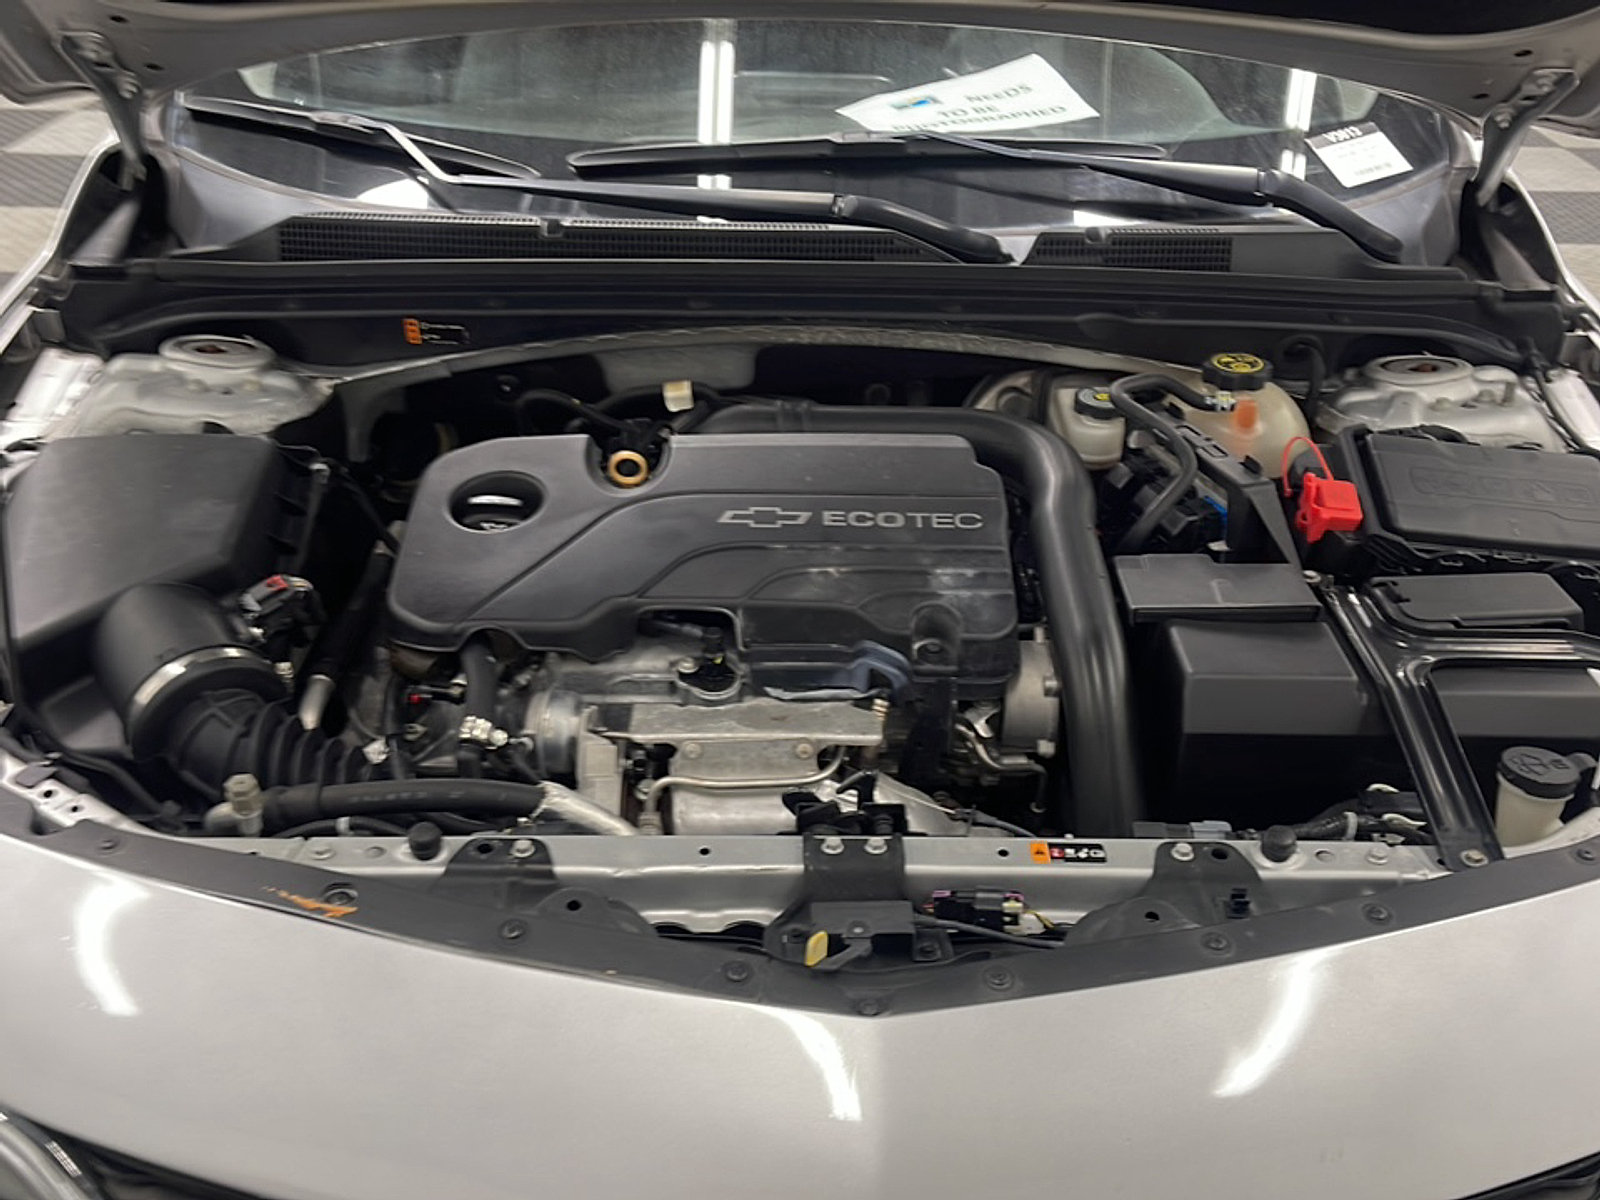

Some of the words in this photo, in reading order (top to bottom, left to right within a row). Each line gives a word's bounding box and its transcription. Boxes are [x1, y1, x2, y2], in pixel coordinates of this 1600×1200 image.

[965, 84, 1032, 103] NEEDS
[893, 106, 1067, 132] PHOTOGRAPHED
[937, 107, 968, 119] TO
[972, 105, 999, 115] BE
[821, 510, 984, 529] ECOTEC
